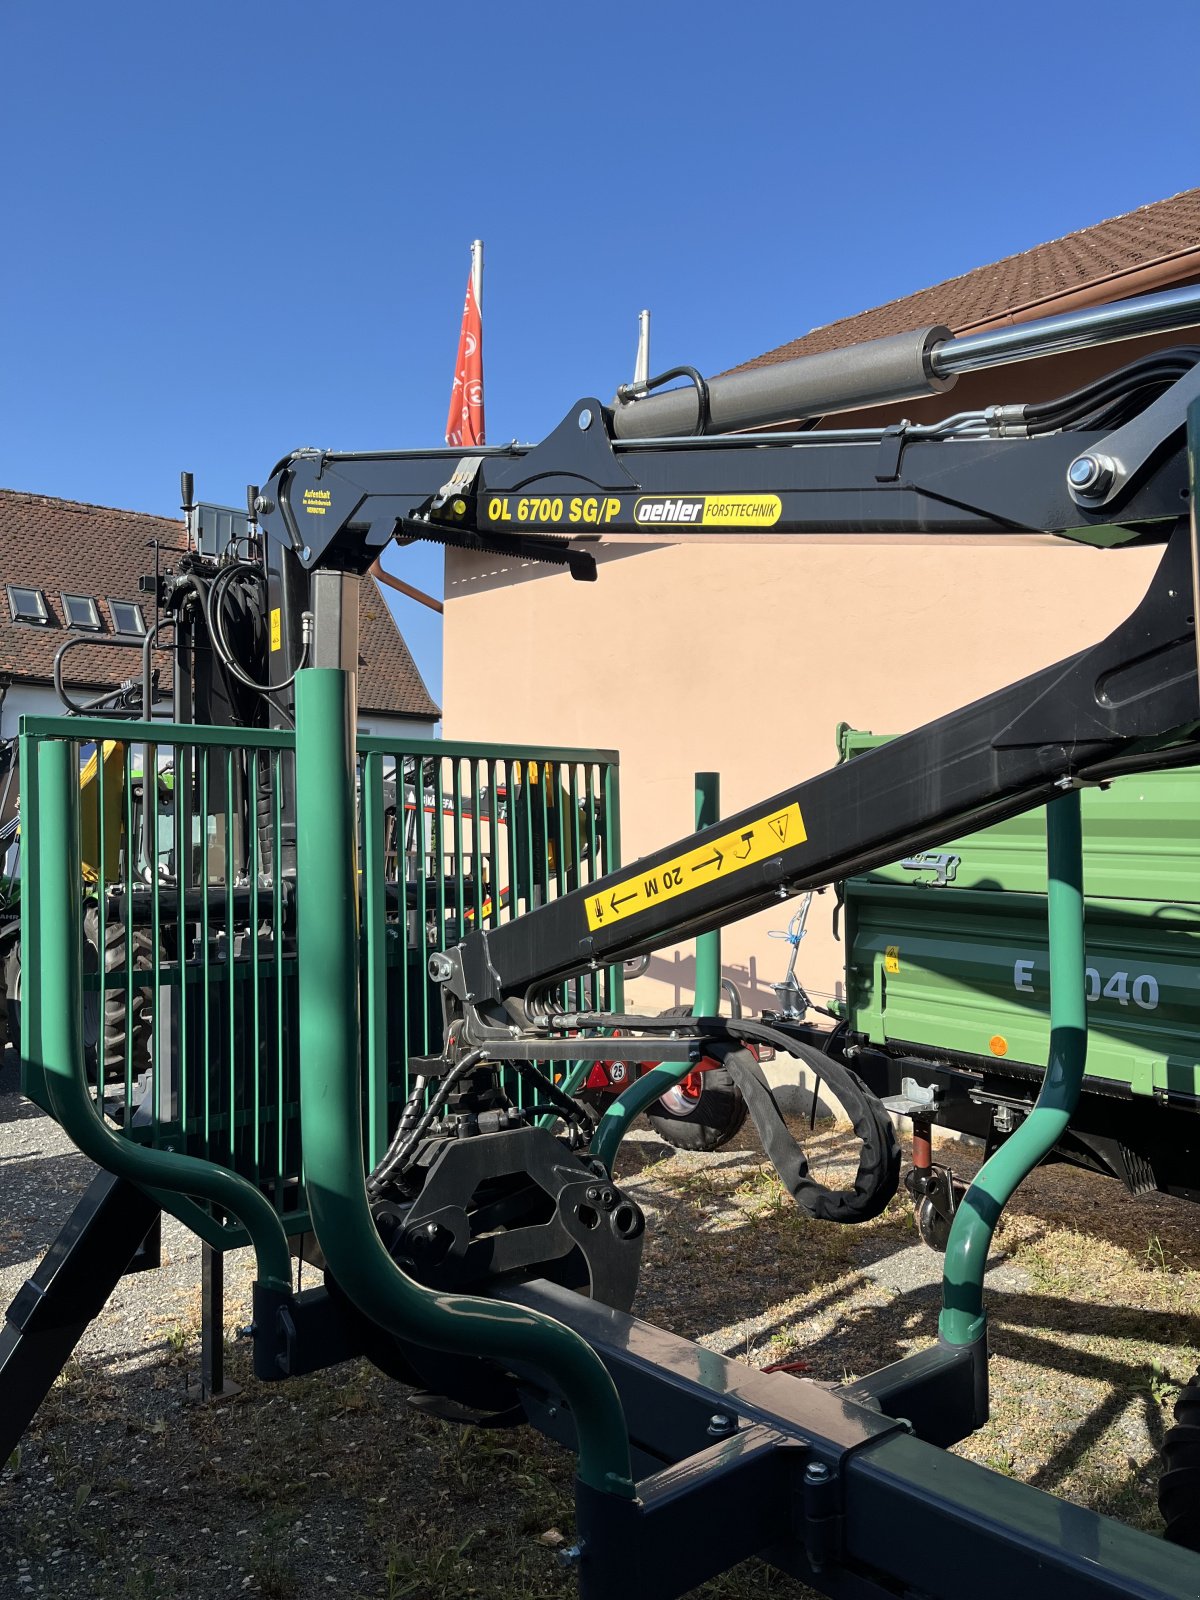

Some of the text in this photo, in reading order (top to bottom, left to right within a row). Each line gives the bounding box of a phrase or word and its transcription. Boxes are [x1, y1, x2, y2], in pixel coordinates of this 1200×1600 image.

[488, 497, 622, 525] OL 6700 SG/P
[638, 499, 777, 522] oehler FORSTTECHNIK
[644, 866, 684, 898] 20 M
[1013, 959, 1160, 1010] E 040
[613, 1065, 623, 1078] 25
